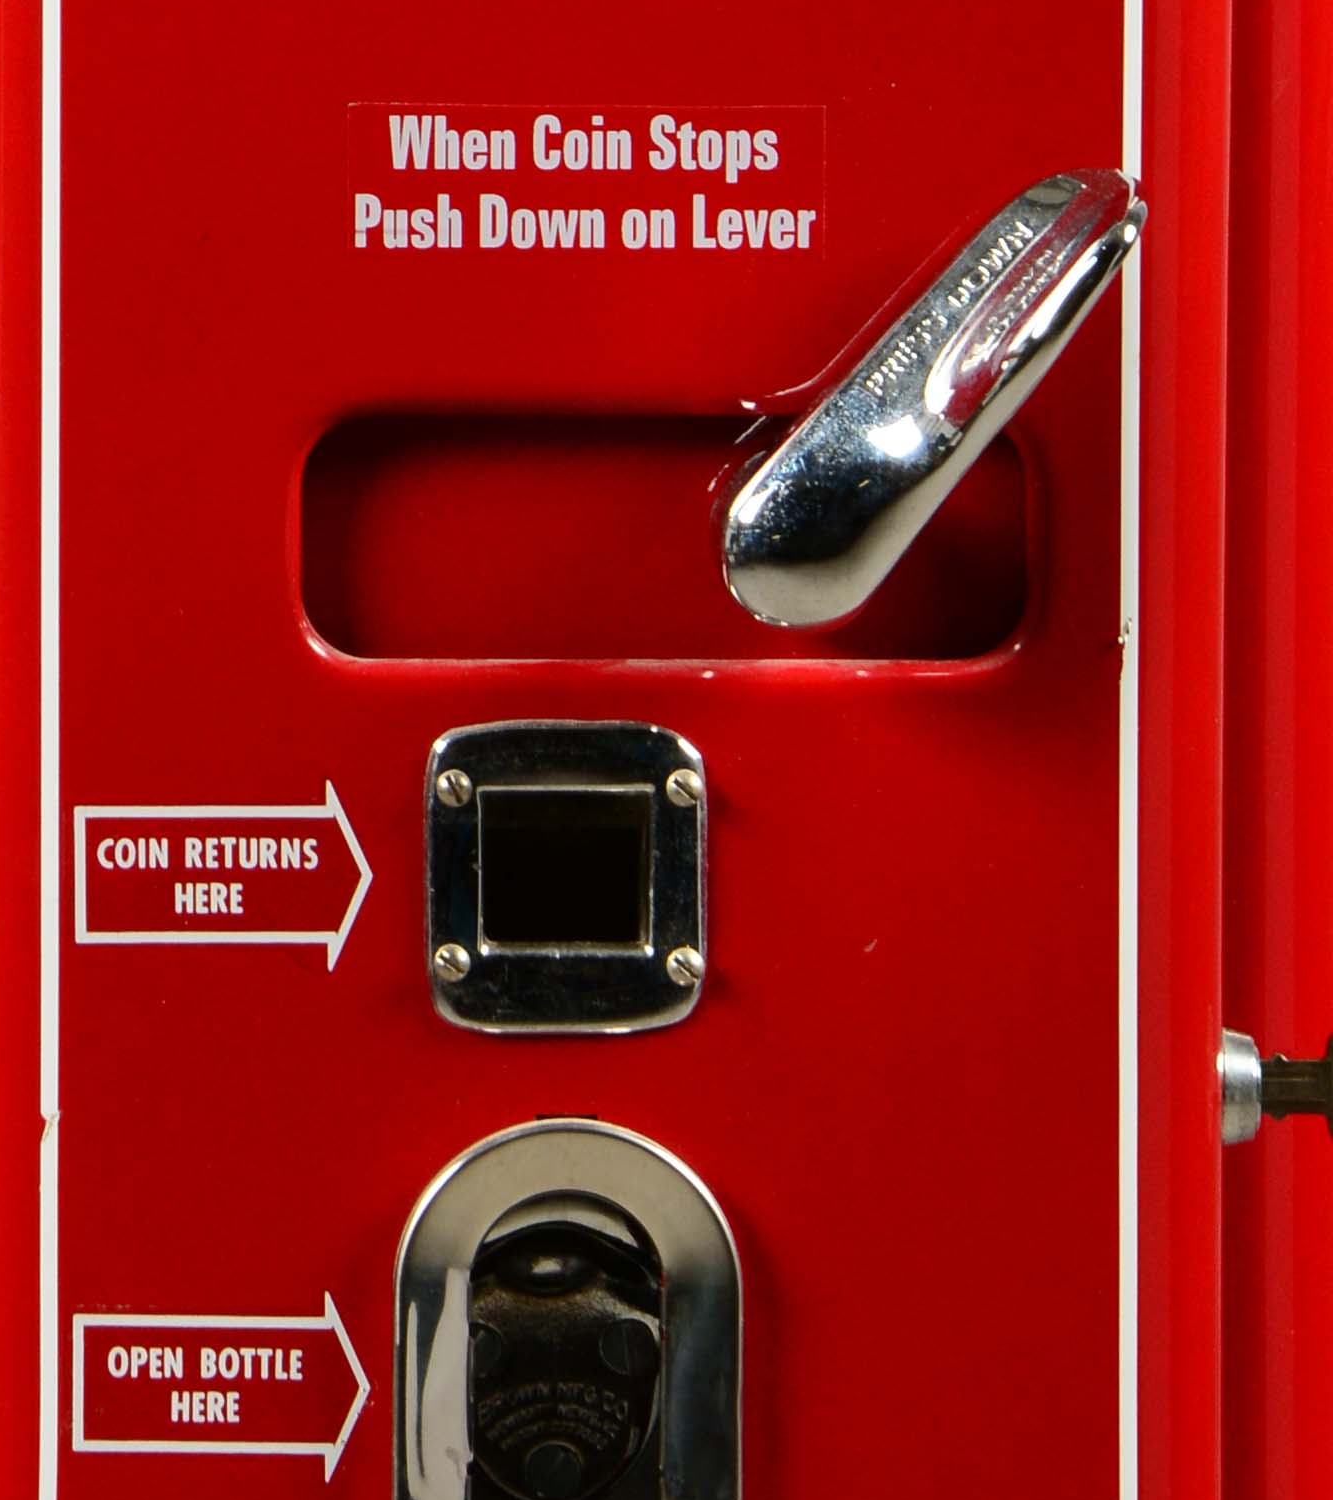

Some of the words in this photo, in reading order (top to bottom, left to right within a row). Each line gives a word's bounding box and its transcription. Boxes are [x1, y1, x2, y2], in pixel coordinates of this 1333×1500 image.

[388, 114, 516, 171] When
[532, 113, 632, 171] Coin
[648, 114, 779, 184] Stops
[354, 193, 463, 249] Push
[479, 193, 606, 250] Down
[620, 208, 676, 250] on
[692, 193, 817, 250] Lever
[946, 220, 1034, 308] DOWN
[96, 837, 169, 870] COIN
[184, 836, 320, 870] RETURNS
[174, 881, 244, 915] HERE
[107, 1345, 184, 1380] OPEN
[200, 1346, 303, 1381] BOTTLE
[170, 1390, 240, 1424] HERE
